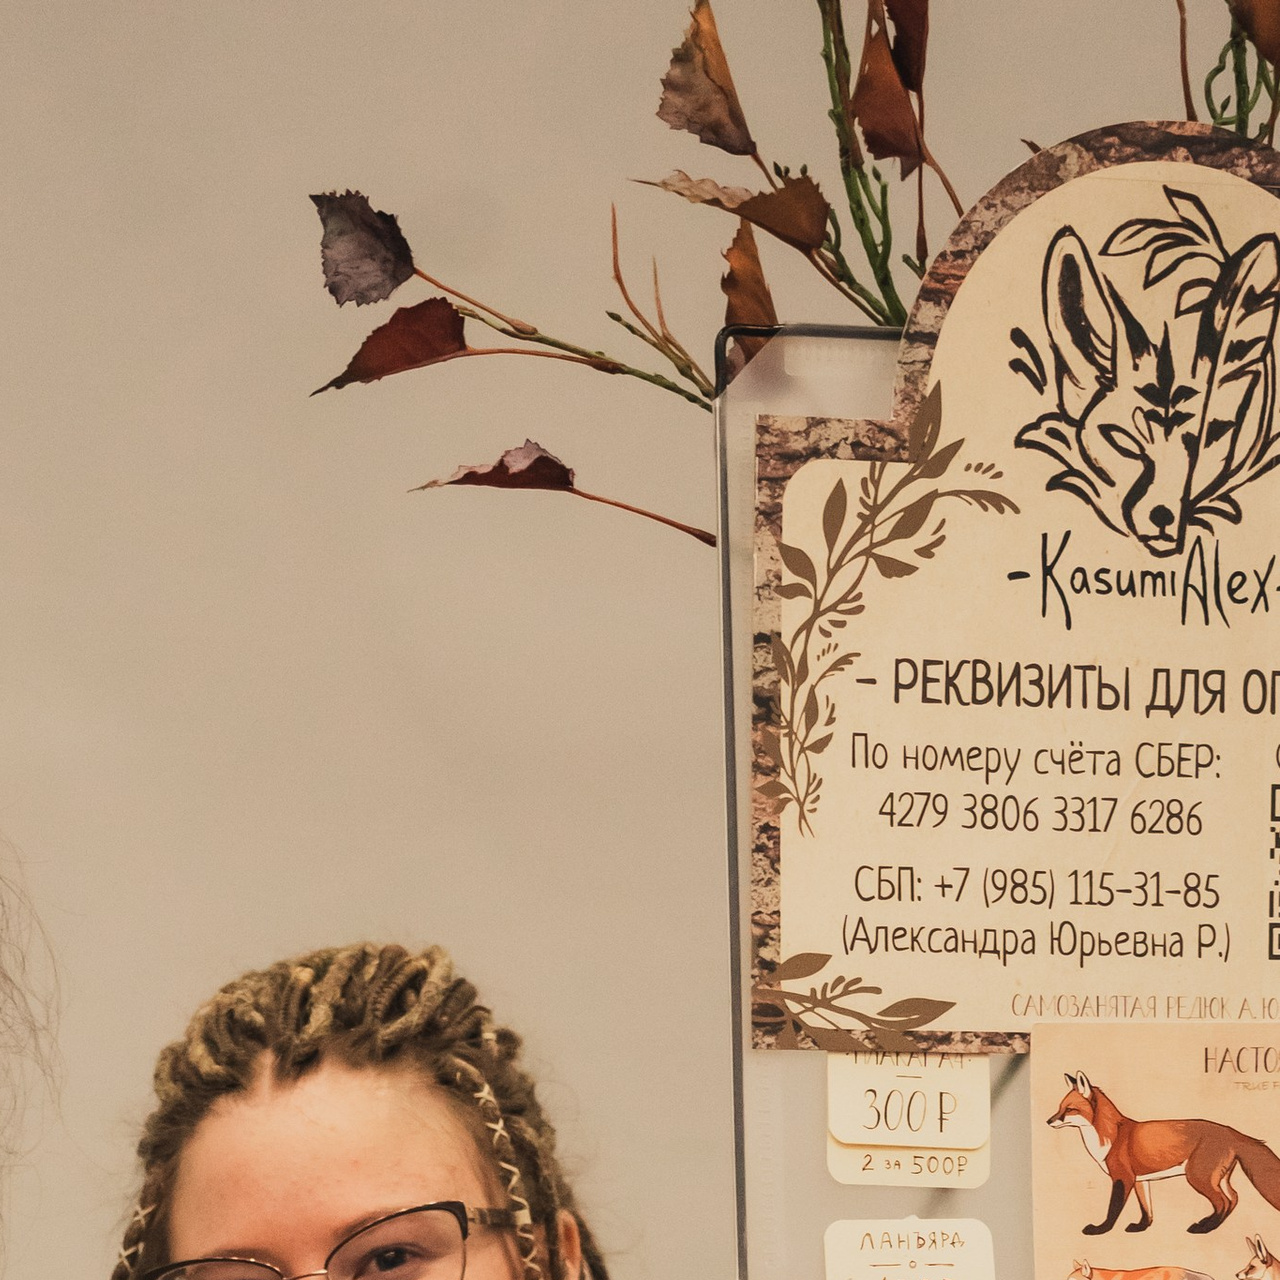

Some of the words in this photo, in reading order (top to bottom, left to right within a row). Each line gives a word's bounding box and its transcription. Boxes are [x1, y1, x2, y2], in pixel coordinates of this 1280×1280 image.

[894, 658, 1130, 711] РЕКВИЗИТЫ
[1145, 668, 1225, 718] ДЛЯ
[851, 732, 888, 769] По
[903, 745, 1021, 785] номеру
[1034, 741, 1120, 775] счёта
[1135, 742, 1221, 779] СБЕР:
[878, 792, 949, 828] 4279
[961, 793, 1039, 832] 3806
[1052, 796, 1118, 832] 3317
[1131, 799, 1202, 836] 6286
[855, 865, 921, 902] СБП:
[934, 867, 970, 902] +7
[983, 867, 1055, 909] (985)
[1068, 869, 1220, 909] 115-31-85
[842, 914, 1036, 967] (Александра
[1050, 920, 1184, 968] Юрьевна
[1198, 923, 1231, 963] Р.)
[1011, 993, 1157, 1018] САМОЗАНЯТАЯ
[1166, 995, 1232, 1020] РЕДЮК
[1204, 1047, 1280, 1074] НАСТО
[862, 1088, 927, 1132] 300
[862, 1154, 875, 1171] 2
[860, 1231, 965, 1250] ЛАНЪЯРД
